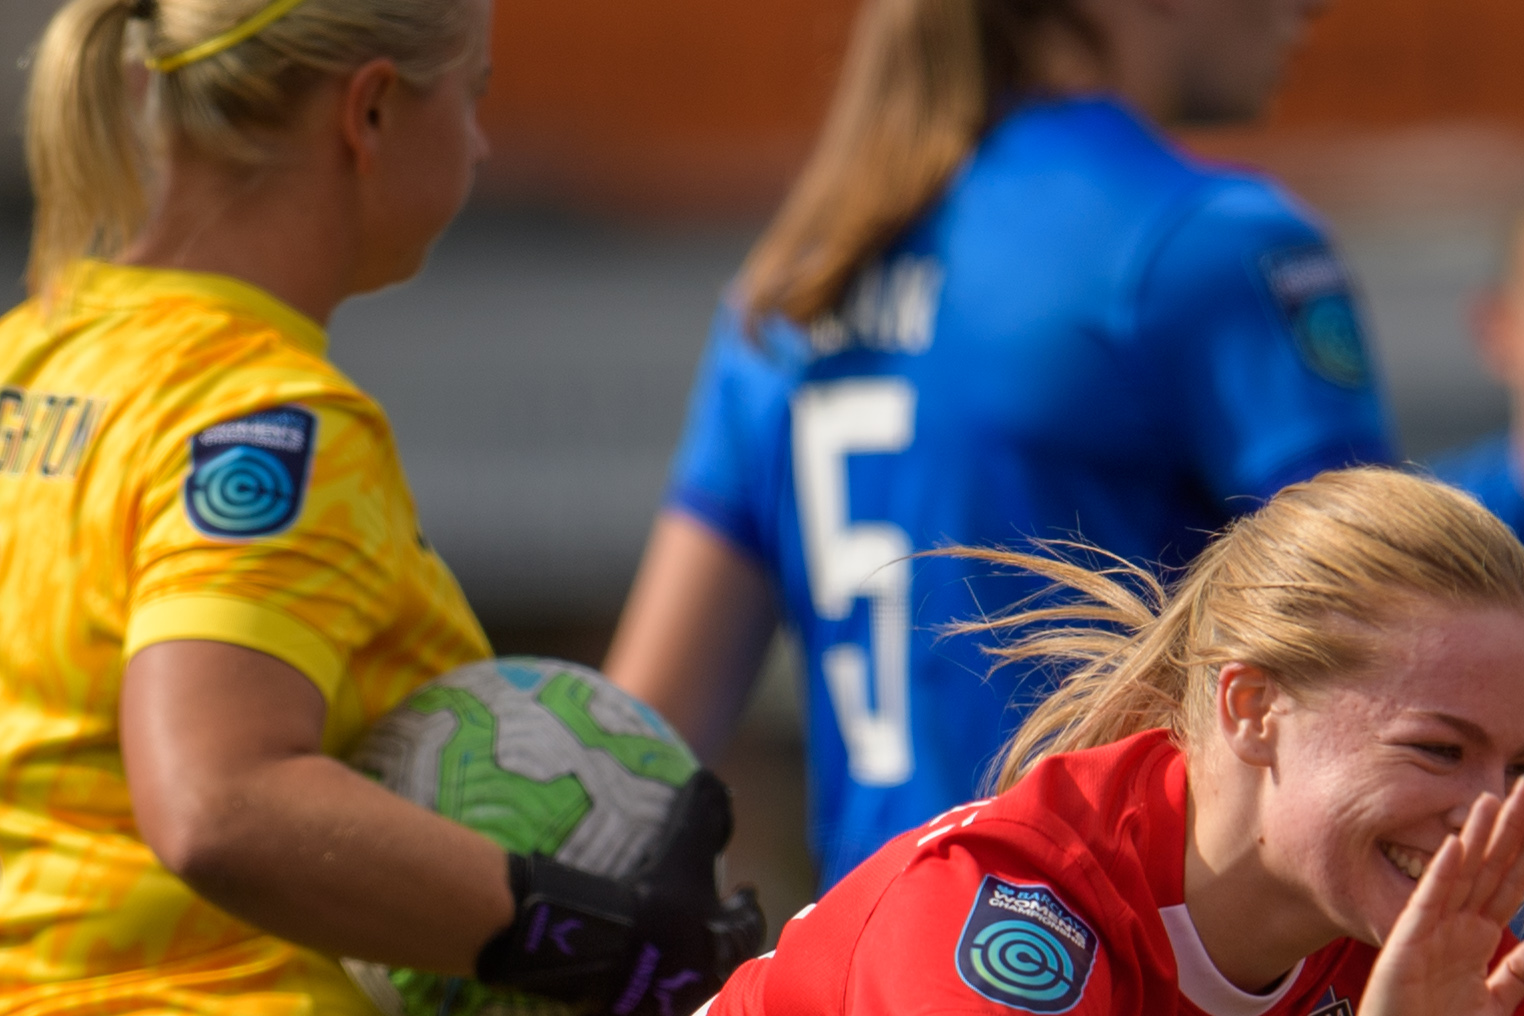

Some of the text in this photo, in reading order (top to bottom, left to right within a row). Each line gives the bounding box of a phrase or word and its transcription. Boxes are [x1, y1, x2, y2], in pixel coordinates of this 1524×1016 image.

[791, 375, 917, 787] 5
[988, 897, 1086, 950] CHAMPIONSHIP
[993, 889, 1086, 946] WOMEN'S
[1017, 891, 1088, 939] BARCLAYS
